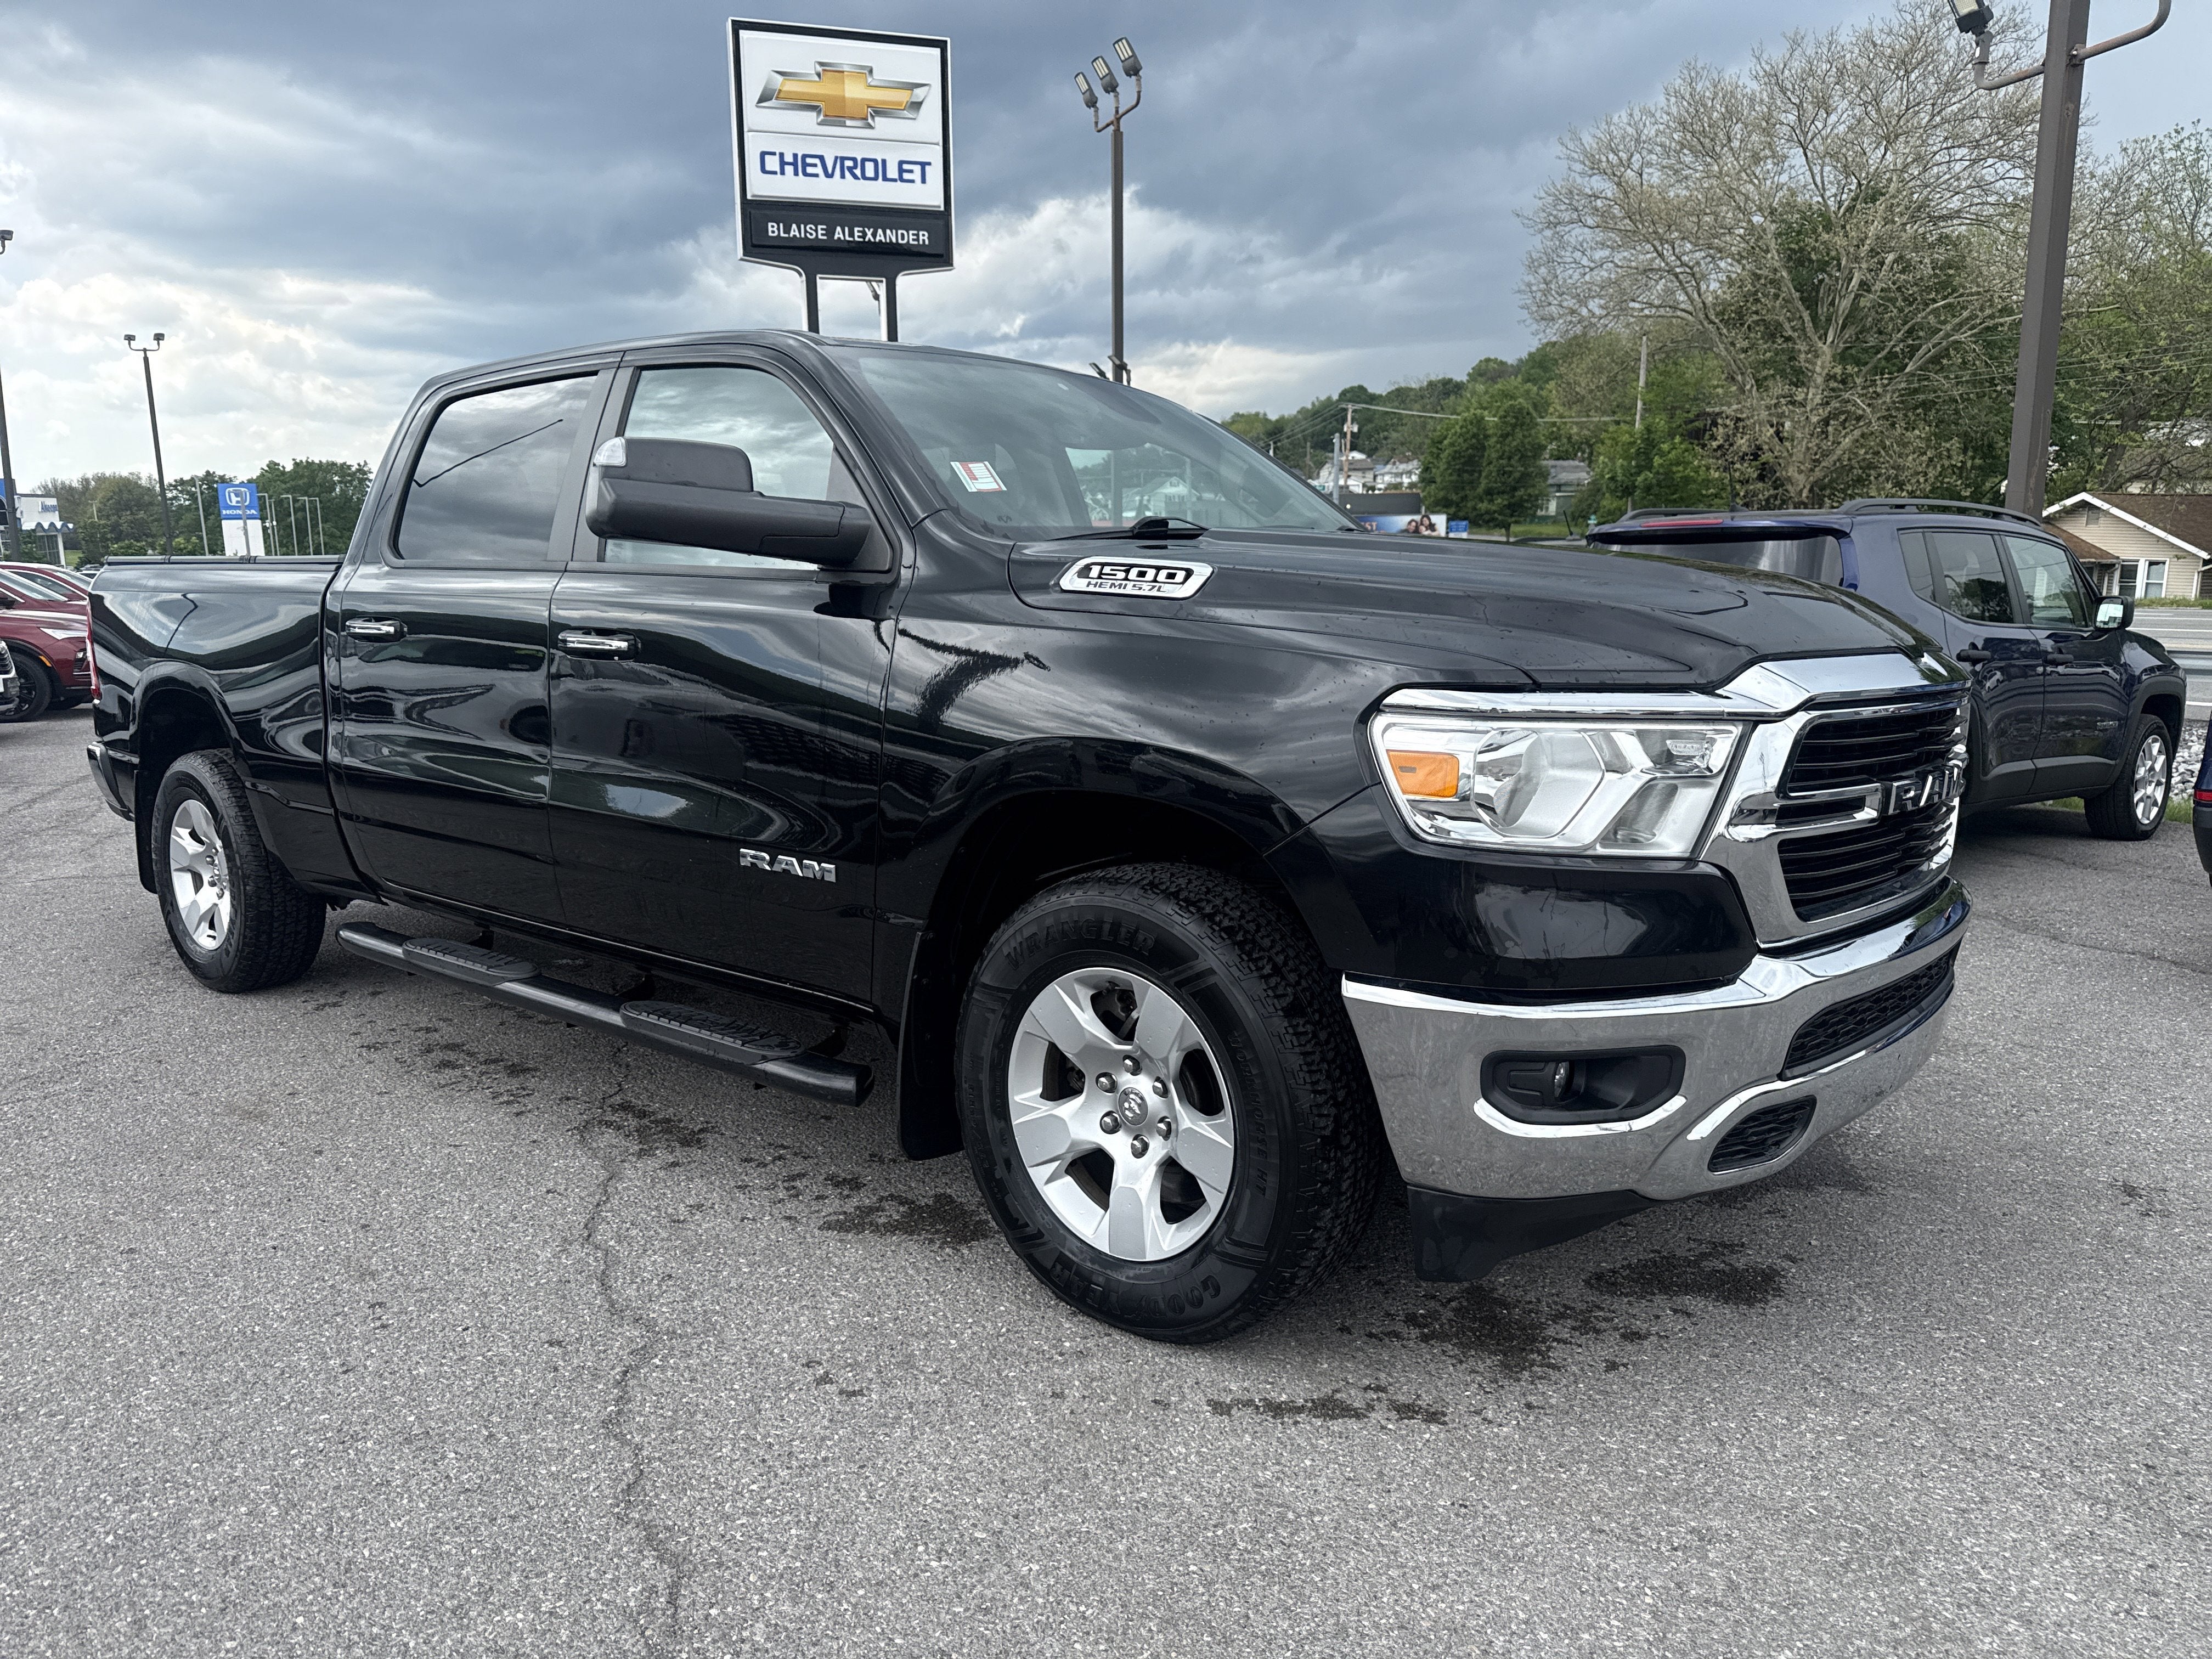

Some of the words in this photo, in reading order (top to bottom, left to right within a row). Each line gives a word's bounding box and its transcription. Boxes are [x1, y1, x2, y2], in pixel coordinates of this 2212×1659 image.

[759, 151, 932, 184] CHEVROLET
[768, 222, 827, 239] BLAISE
[833, 226, 929, 245] ALEXANDER
[1086, 581, 1126, 590] HEMI
[1132, 584, 1166, 592] 5.7L
[1088, 565, 1187, 583] 1500
[740, 848, 836, 883] RAM
[1004, 917, 1155, 970] WRANGLER
[1228, 1031, 1268, 1161] WORKHORSE
[1049, 1263, 1221, 1318] GOODYEAR
